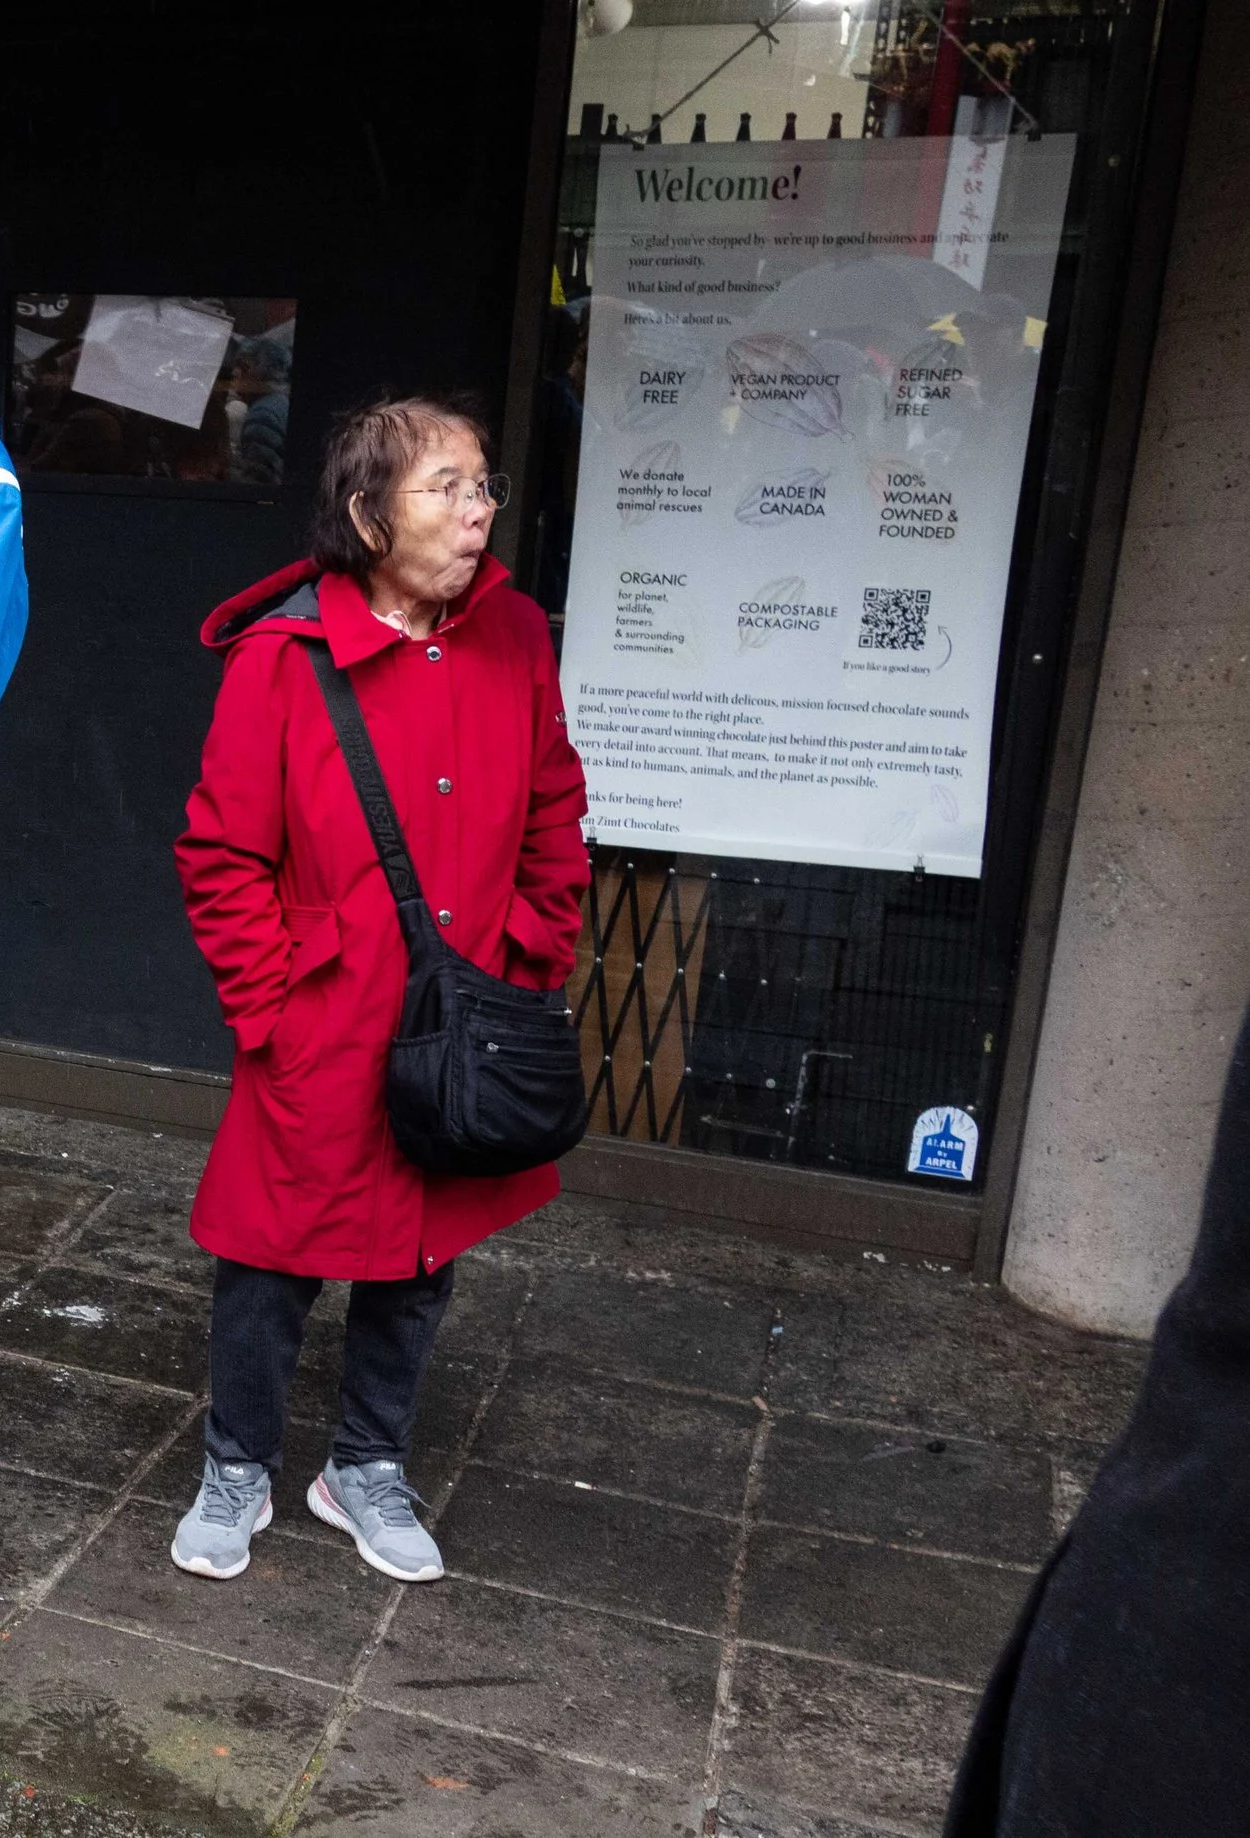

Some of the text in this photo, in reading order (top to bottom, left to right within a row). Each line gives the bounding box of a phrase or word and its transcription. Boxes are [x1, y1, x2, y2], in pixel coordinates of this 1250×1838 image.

[635, 165, 801, 202] Welcome!
[646, 235, 669, 250] glad
[707, 234, 750, 249] stopped
[774, 233, 801, 245] we're
[804, 235, 819, 248] up
[823, 233, 834, 244] to
[836, 232, 865, 246] good
[868, 232, 918, 245] business
[628, 255, 705, 269] your curiosity.
[628, 281, 781, 295] What kind of good business?
[682, 314, 731, 325] about us,
[640, 371, 686, 385] DAIRY
[732, 374, 840, 386] VEGAN PRODUCT
[900, 369, 963, 382] REFINED
[643, 390, 678, 404] FREE
[741, 389, 807, 400] COMPANY
[898, 386, 950, 399] SUGAR
[895, 404, 930, 416] FREE
[620, 469, 684, 481] We donate
[888, 474, 925, 487] 100%
[618, 485, 711, 498] monthly to local
[761, 487, 825, 498] MADE IN
[883, 491, 952, 504] WOMAN
[617, 500, 702, 512] animal rescues
[760, 502, 825, 516] CANADA
[881, 508, 958, 522] OWNED &
[879, 525, 955, 539] FOUNDED
[620, 572, 687, 586] ORGANIC
[618, 589, 668, 602] for planet,
[617, 603, 654, 615] wildlife,
[739, 603, 838, 618] COMPOSTABLE
[616, 616, 653, 627] farmers
[738, 617, 819, 631] PACKAGING
[615, 629, 685, 644] & surrounding
[614, 643, 673, 654] communities
[850, 663, 865, 672] you
[866, 662, 881, 671] like
[888, 664, 909, 674] good
[911, 666, 930, 677] story
[580, 684, 969, 720] If a more peaceful world with delicous, mission focused chocolate sounds
[578, 703, 764, 726] good, you've come to the right place.
[577, 720, 967, 758] We make our award winning chocolate just behind this poster and aim to take
[575, 739, 601, 752] every
[604, 737, 633, 752] detail
[636, 741, 655, 753] into
[658, 744, 702, 757] account.
[707, 746, 728, 758] That
[732, 750, 769, 762] means,
[775, 752, 785, 762] to
[788, 752, 817, 764] make
[820, 754, 827, 765] it
[831, 755, 848, 767] not
[852, 757, 874, 771] only
[877, 759, 931, 776] extremely
[592, 756, 878, 788] as kind to humans, animals, and the planet as possible.
[609, 791, 682, 809] for being here!
[597, 815, 680, 832] Zimt Chocolates
[926, 1138, 963, 1151] ALARM
[925, 1157, 957, 1169] ARPEL
[225, 1466, 244, 1475] FILA
[379, 1462, 396, 1470] FILA
